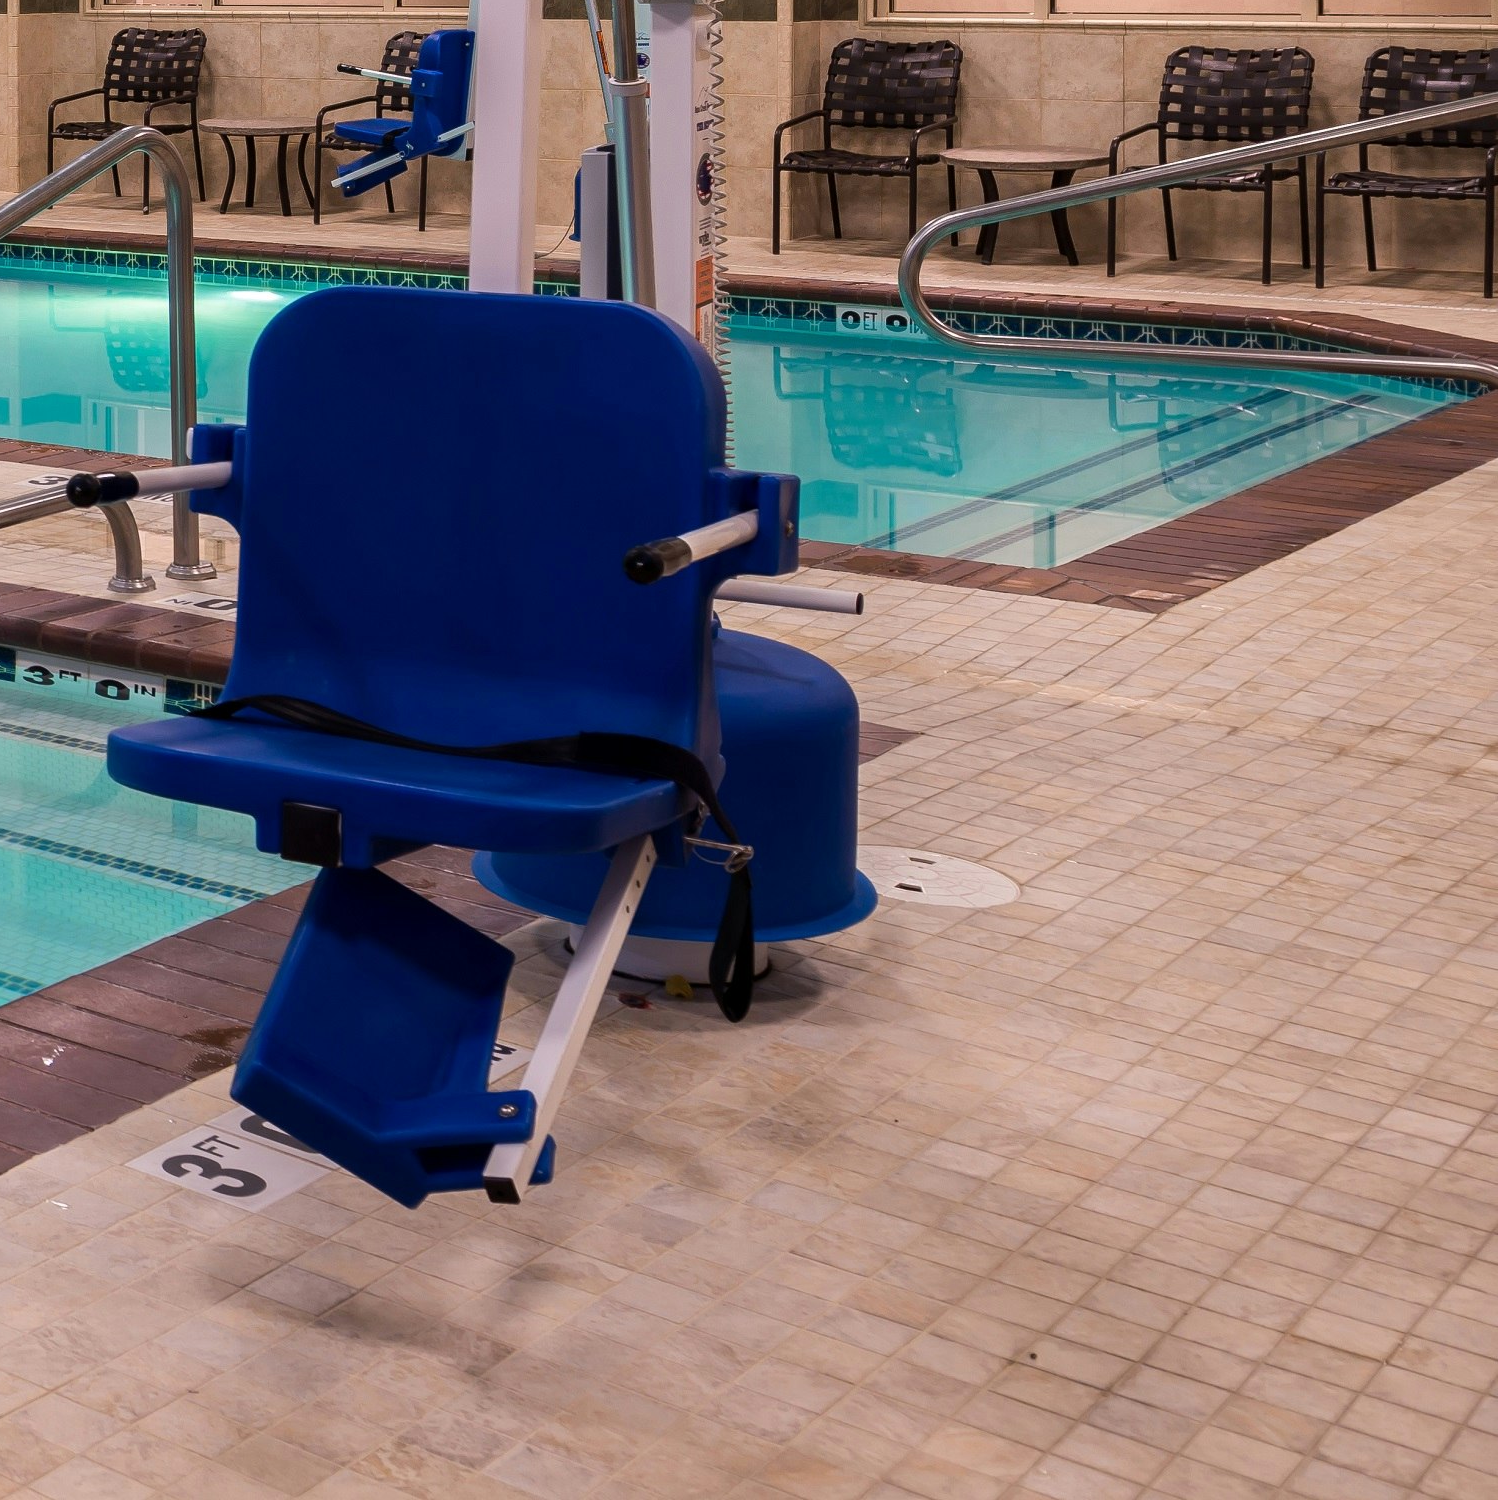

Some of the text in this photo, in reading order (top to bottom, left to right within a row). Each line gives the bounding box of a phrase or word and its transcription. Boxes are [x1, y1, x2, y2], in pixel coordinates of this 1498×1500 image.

[23, 665, 156, 700] 3 FT 0 IN
[162, 1134, 268, 1198] 3 FT
